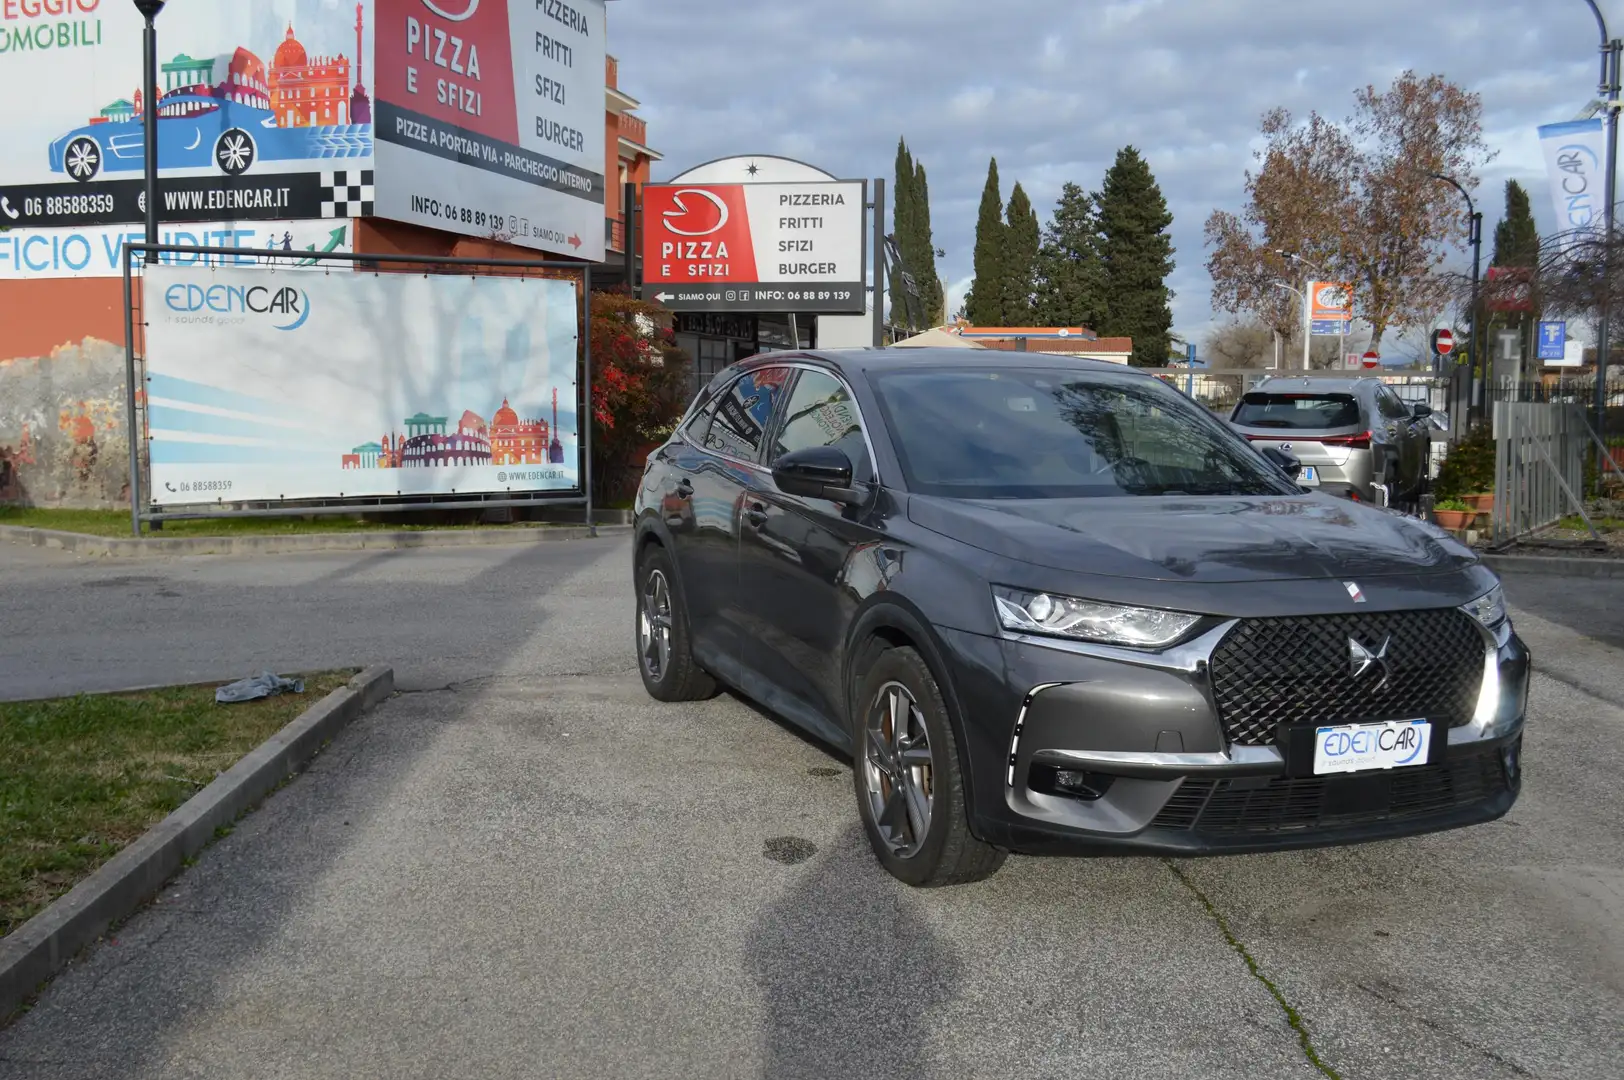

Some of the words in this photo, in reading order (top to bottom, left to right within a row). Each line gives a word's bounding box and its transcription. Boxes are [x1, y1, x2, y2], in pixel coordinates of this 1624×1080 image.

[535, 0, 589, 37] PIZZERIA
[407, 16, 481, 81] PIZZA
[535, 31, 573, 68] FRITTI
[407, 66, 418, 94] E
[437, 78, 482, 116] SFIZI
[535, 74, 566, 106] SFIZI
[536, 116, 584, 152] BURGER
[396, 116, 428, 143] PIZZE
[430, 130, 438, 146] A
[439, 131, 480, 159] PORTAR
[481, 145, 498, 164] VIA
[504, 152, 558, 182] PARCHEGGIO
[559, 170, 592, 193] INTERNO
[24, 198, 42, 216] 06
[46, 194, 114, 215] 88588359
[164, 187, 291, 210] WWW.EDENCAR.IT
[411, 194, 442, 218] INFO:
[445, 204, 458, 221] 06
[460, 209, 473, 225] 88
[475, 211, 487, 227] 89
[489, 214, 504, 231] 139
[779, 193, 845, 206] PIZZERIA
[1556, 151, 1593, 248] ENCAR
[532, 226, 553, 242] SIAMO
[554, 233, 566, 245] QUI
[779, 217, 823, 229] FRITTI
[662, 241, 729, 259] PIZZA
[778, 240, 813, 252] SFIZI
[662, 264, 671, 276] E
[688, 264, 729, 276] SFIZI
[779, 262, 837, 275] BURGER
[165, 284, 300, 313] EDENCAR
[678, 293, 705, 301] SIAMO
[706, 293, 721, 302] QUI
[755, 290, 785, 300] INFO:
[787, 291, 800, 300] 06
[803, 291, 815, 300] 88
[818, 290, 830, 300] 89
[833, 290, 851, 300] 139
[175, 315, 214, 324] sounds
[180, 481, 190, 492] 06
[193, 480, 232, 491] 88588359
[508, 470, 564, 481] WWW.EDENCAR.IT
[1324, 726, 1415, 756] EDENCAR
